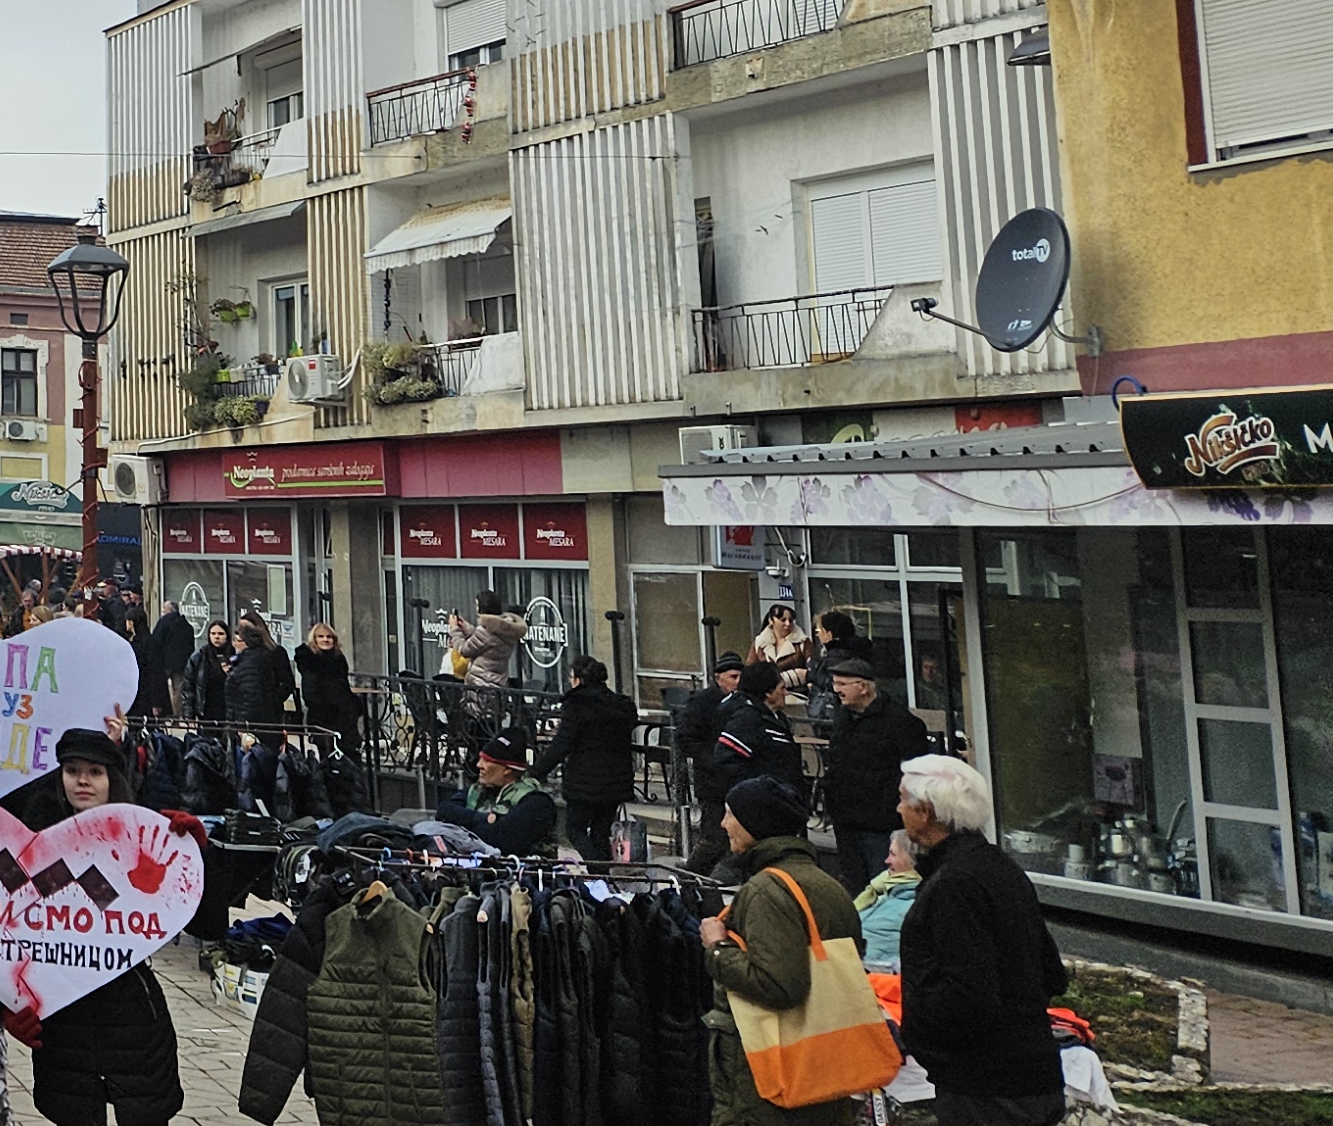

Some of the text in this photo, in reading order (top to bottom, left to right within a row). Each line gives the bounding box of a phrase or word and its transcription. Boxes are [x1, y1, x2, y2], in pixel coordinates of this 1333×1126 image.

[234, 465, 274, 481] Neoplanta
[527, 625, 566, 643] ATENANE
[2, 691, 34, 719] УЗ
[24, 904, 94, 934] СМО
[105, 910, 168, 940] ПОД
